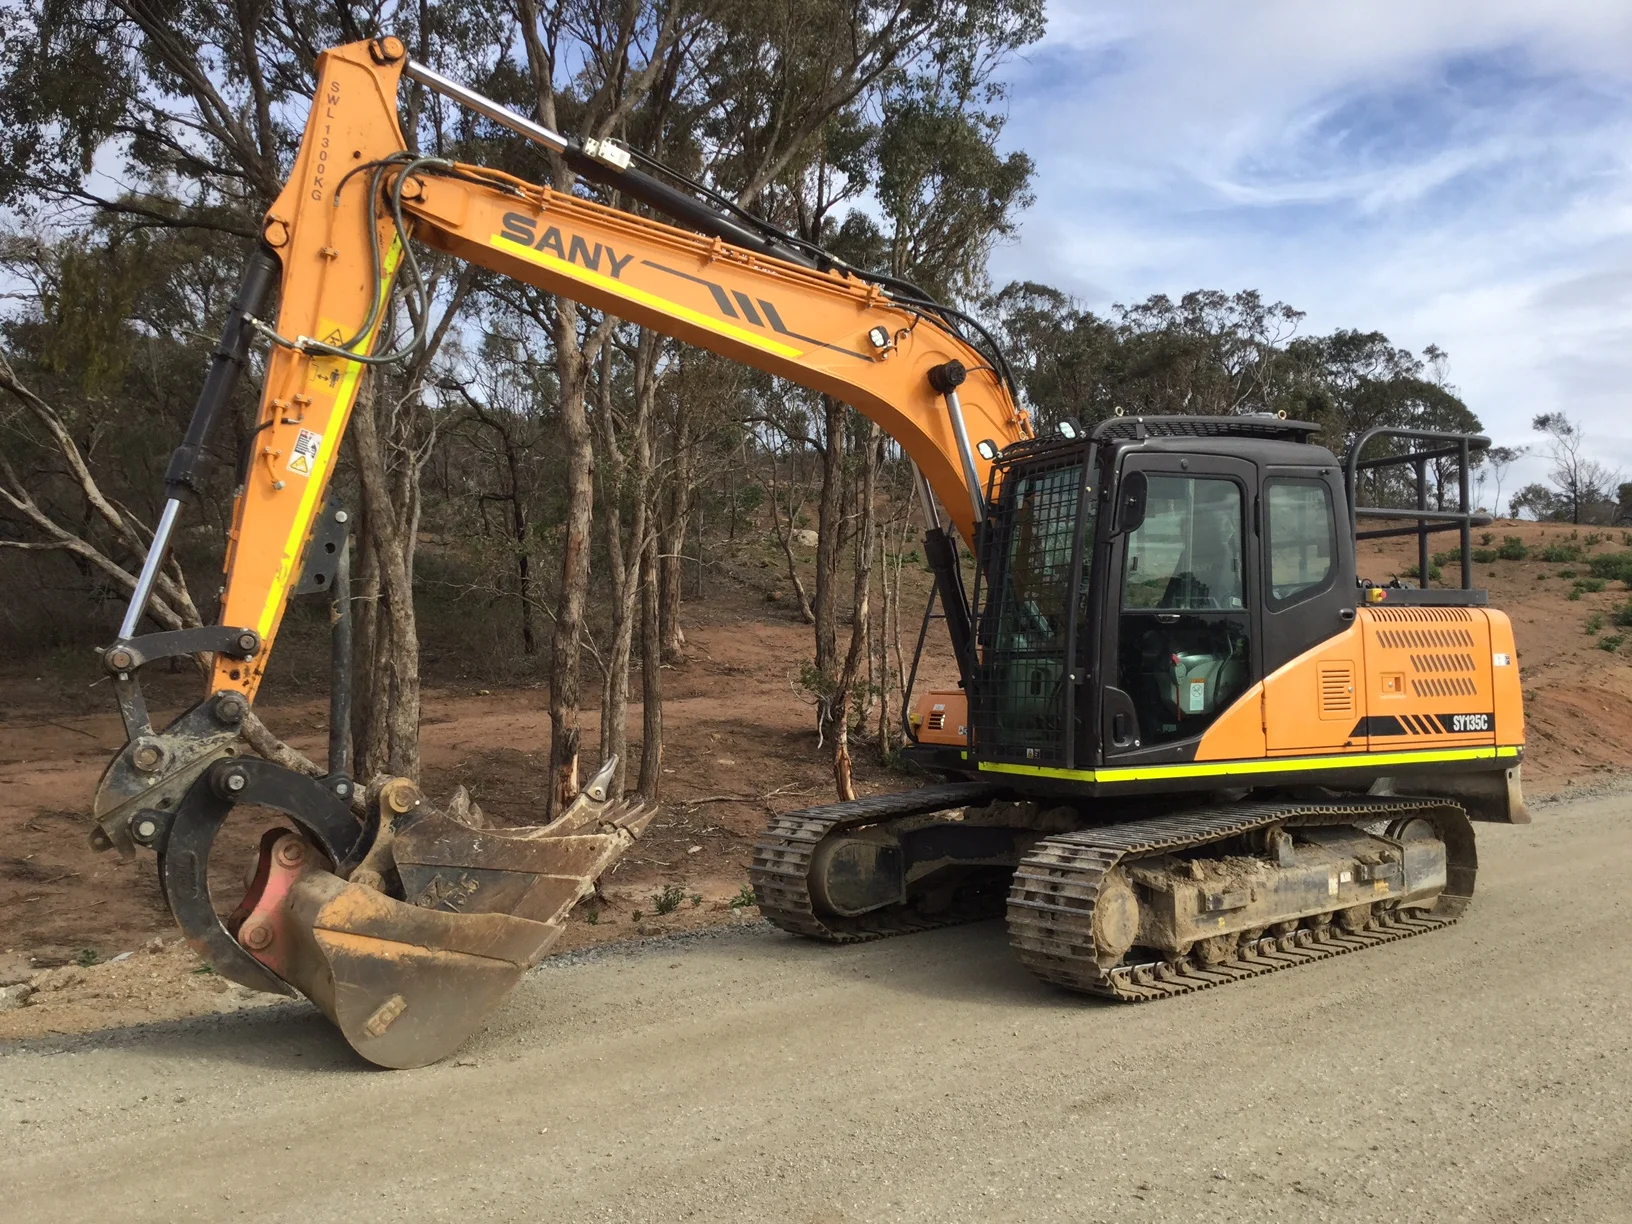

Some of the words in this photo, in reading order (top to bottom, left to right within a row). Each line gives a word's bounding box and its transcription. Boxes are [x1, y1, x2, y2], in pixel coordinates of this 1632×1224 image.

[326, 81, 341, 119] SWL
[311, 124, 330, 201] 1300KG
[500, 211, 635, 279] SANY
[1453, 714, 1488, 731] SY135C
